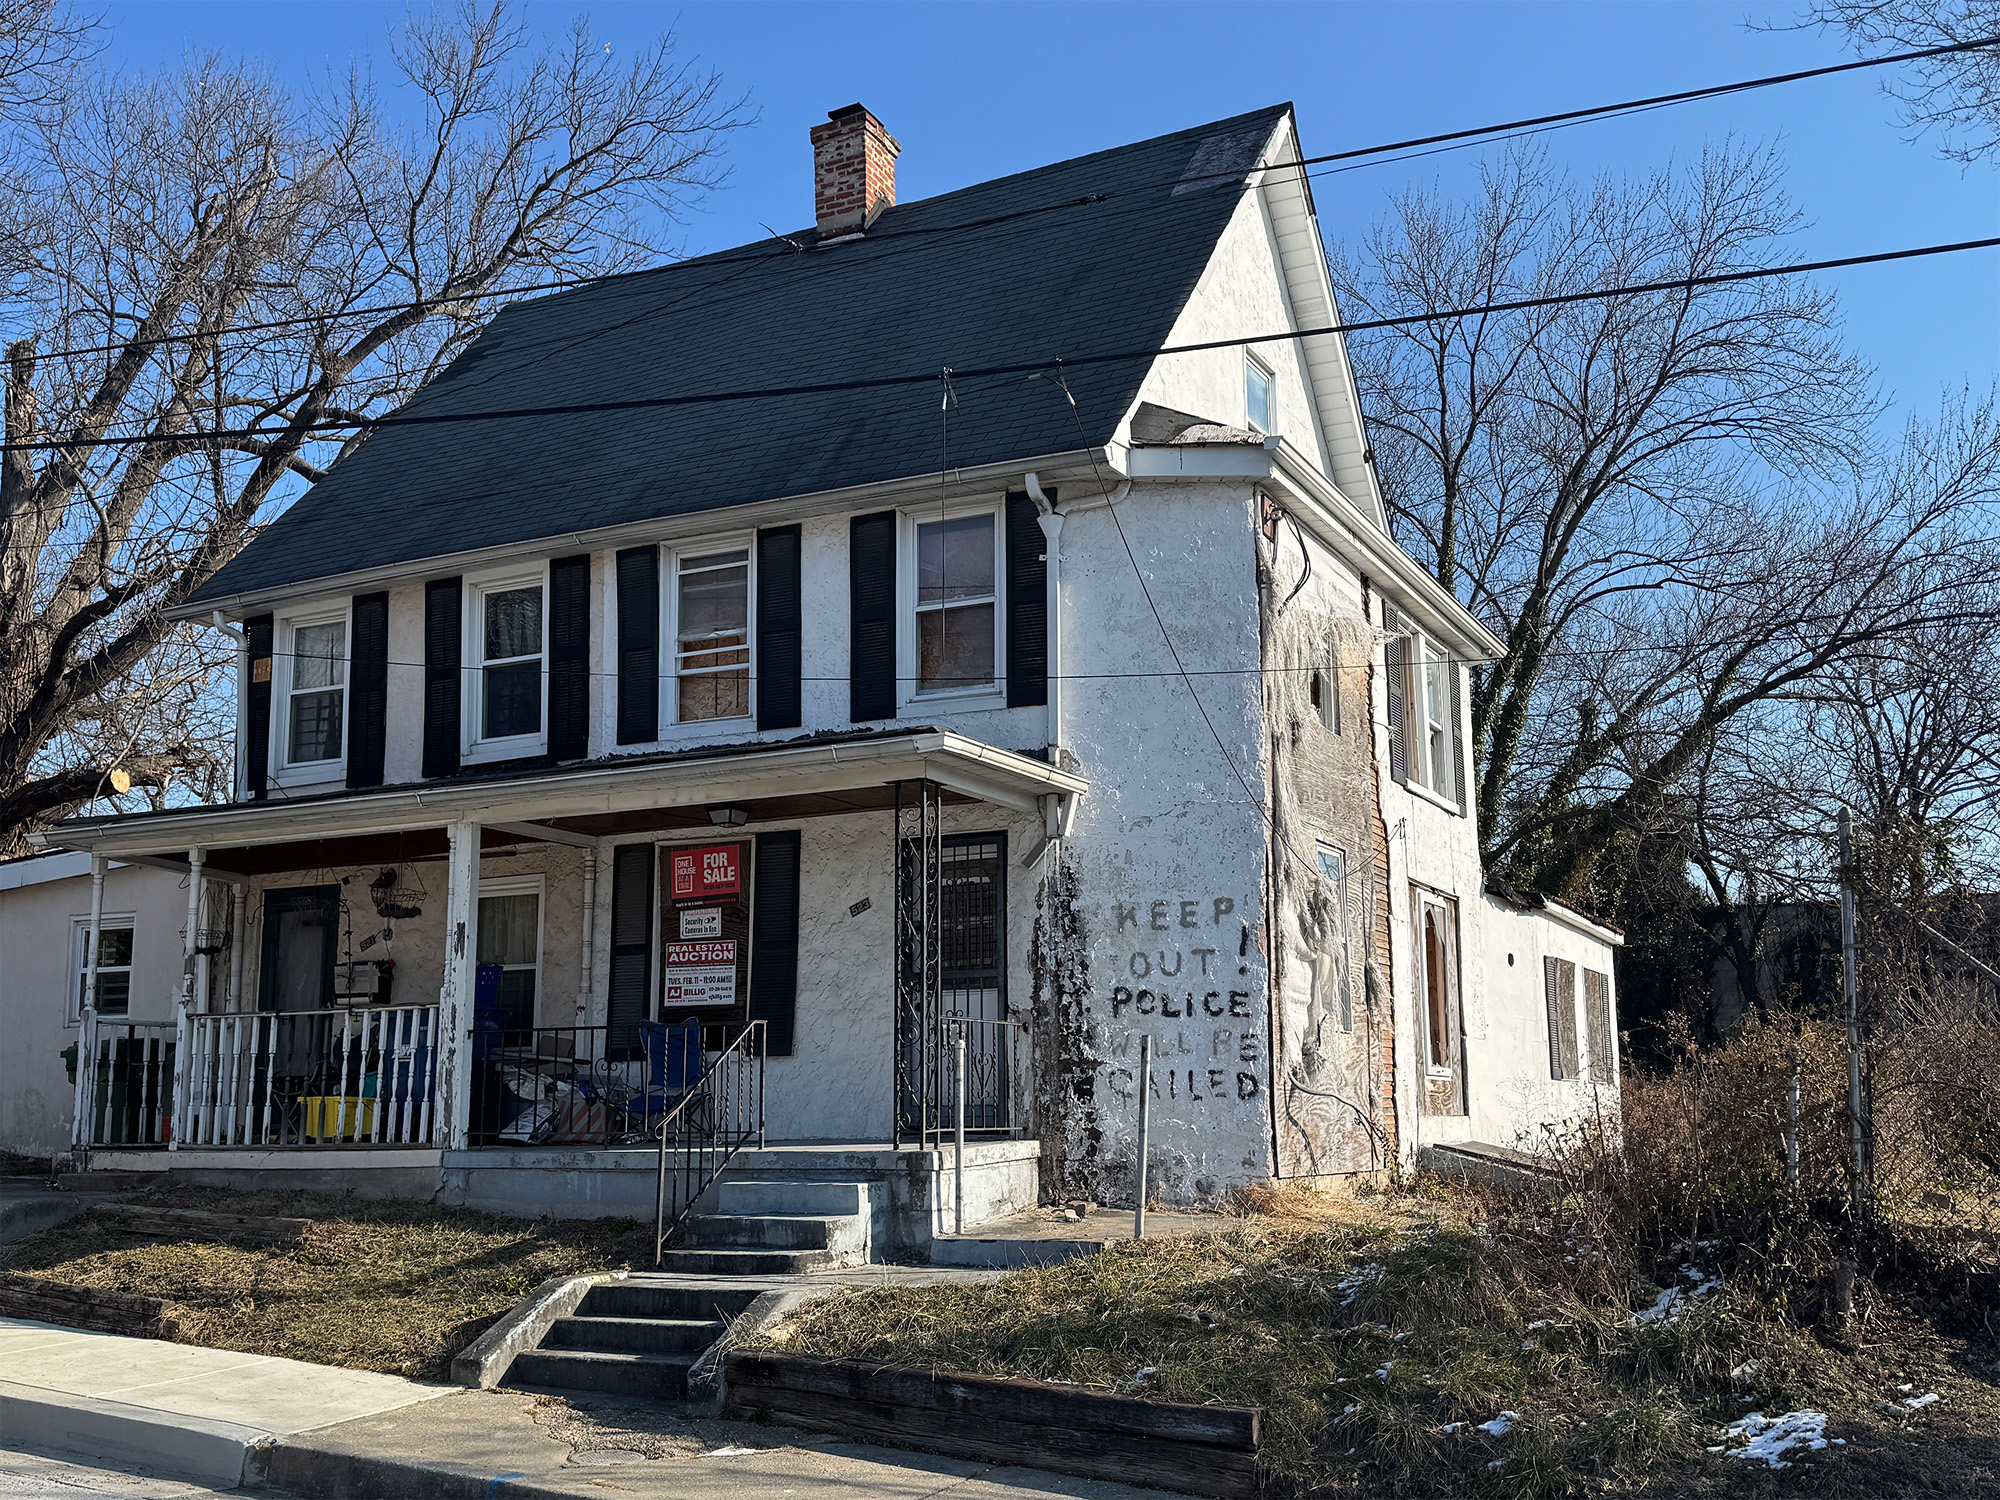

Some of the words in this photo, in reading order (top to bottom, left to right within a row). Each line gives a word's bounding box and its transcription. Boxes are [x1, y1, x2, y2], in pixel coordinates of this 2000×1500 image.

[677, 860, 690, 869] ONE
[703, 852, 728, 868] FOR
[678, 867, 696, 876] HOUSE
[703, 866, 736, 884] SALE
[851, 900, 870, 915] 523
[1111, 898, 1235, 931] KEEP
[684, 917, 703, 926] Security
[684, 926, 703, 935] Cameras
[361, 937, 374, 950] 521
[668, 945, 694, 953] REAL
[695, 943, 734, 951] ESTATE
[668, 950, 734, 962] AUCTION
[668, 977, 682, 986] TUES.
[683, 976, 694, 985] FEB.
[703, 975, 716, 984] 11:00
[717, 975, 726, 983] AM
[670, 988, 680, 997] AJ
[683, 988, 706, 996] BILLIG
[1111, 986, 1252, 1018] POLICE
[1111, 1031, 1194, 1057] WLL
